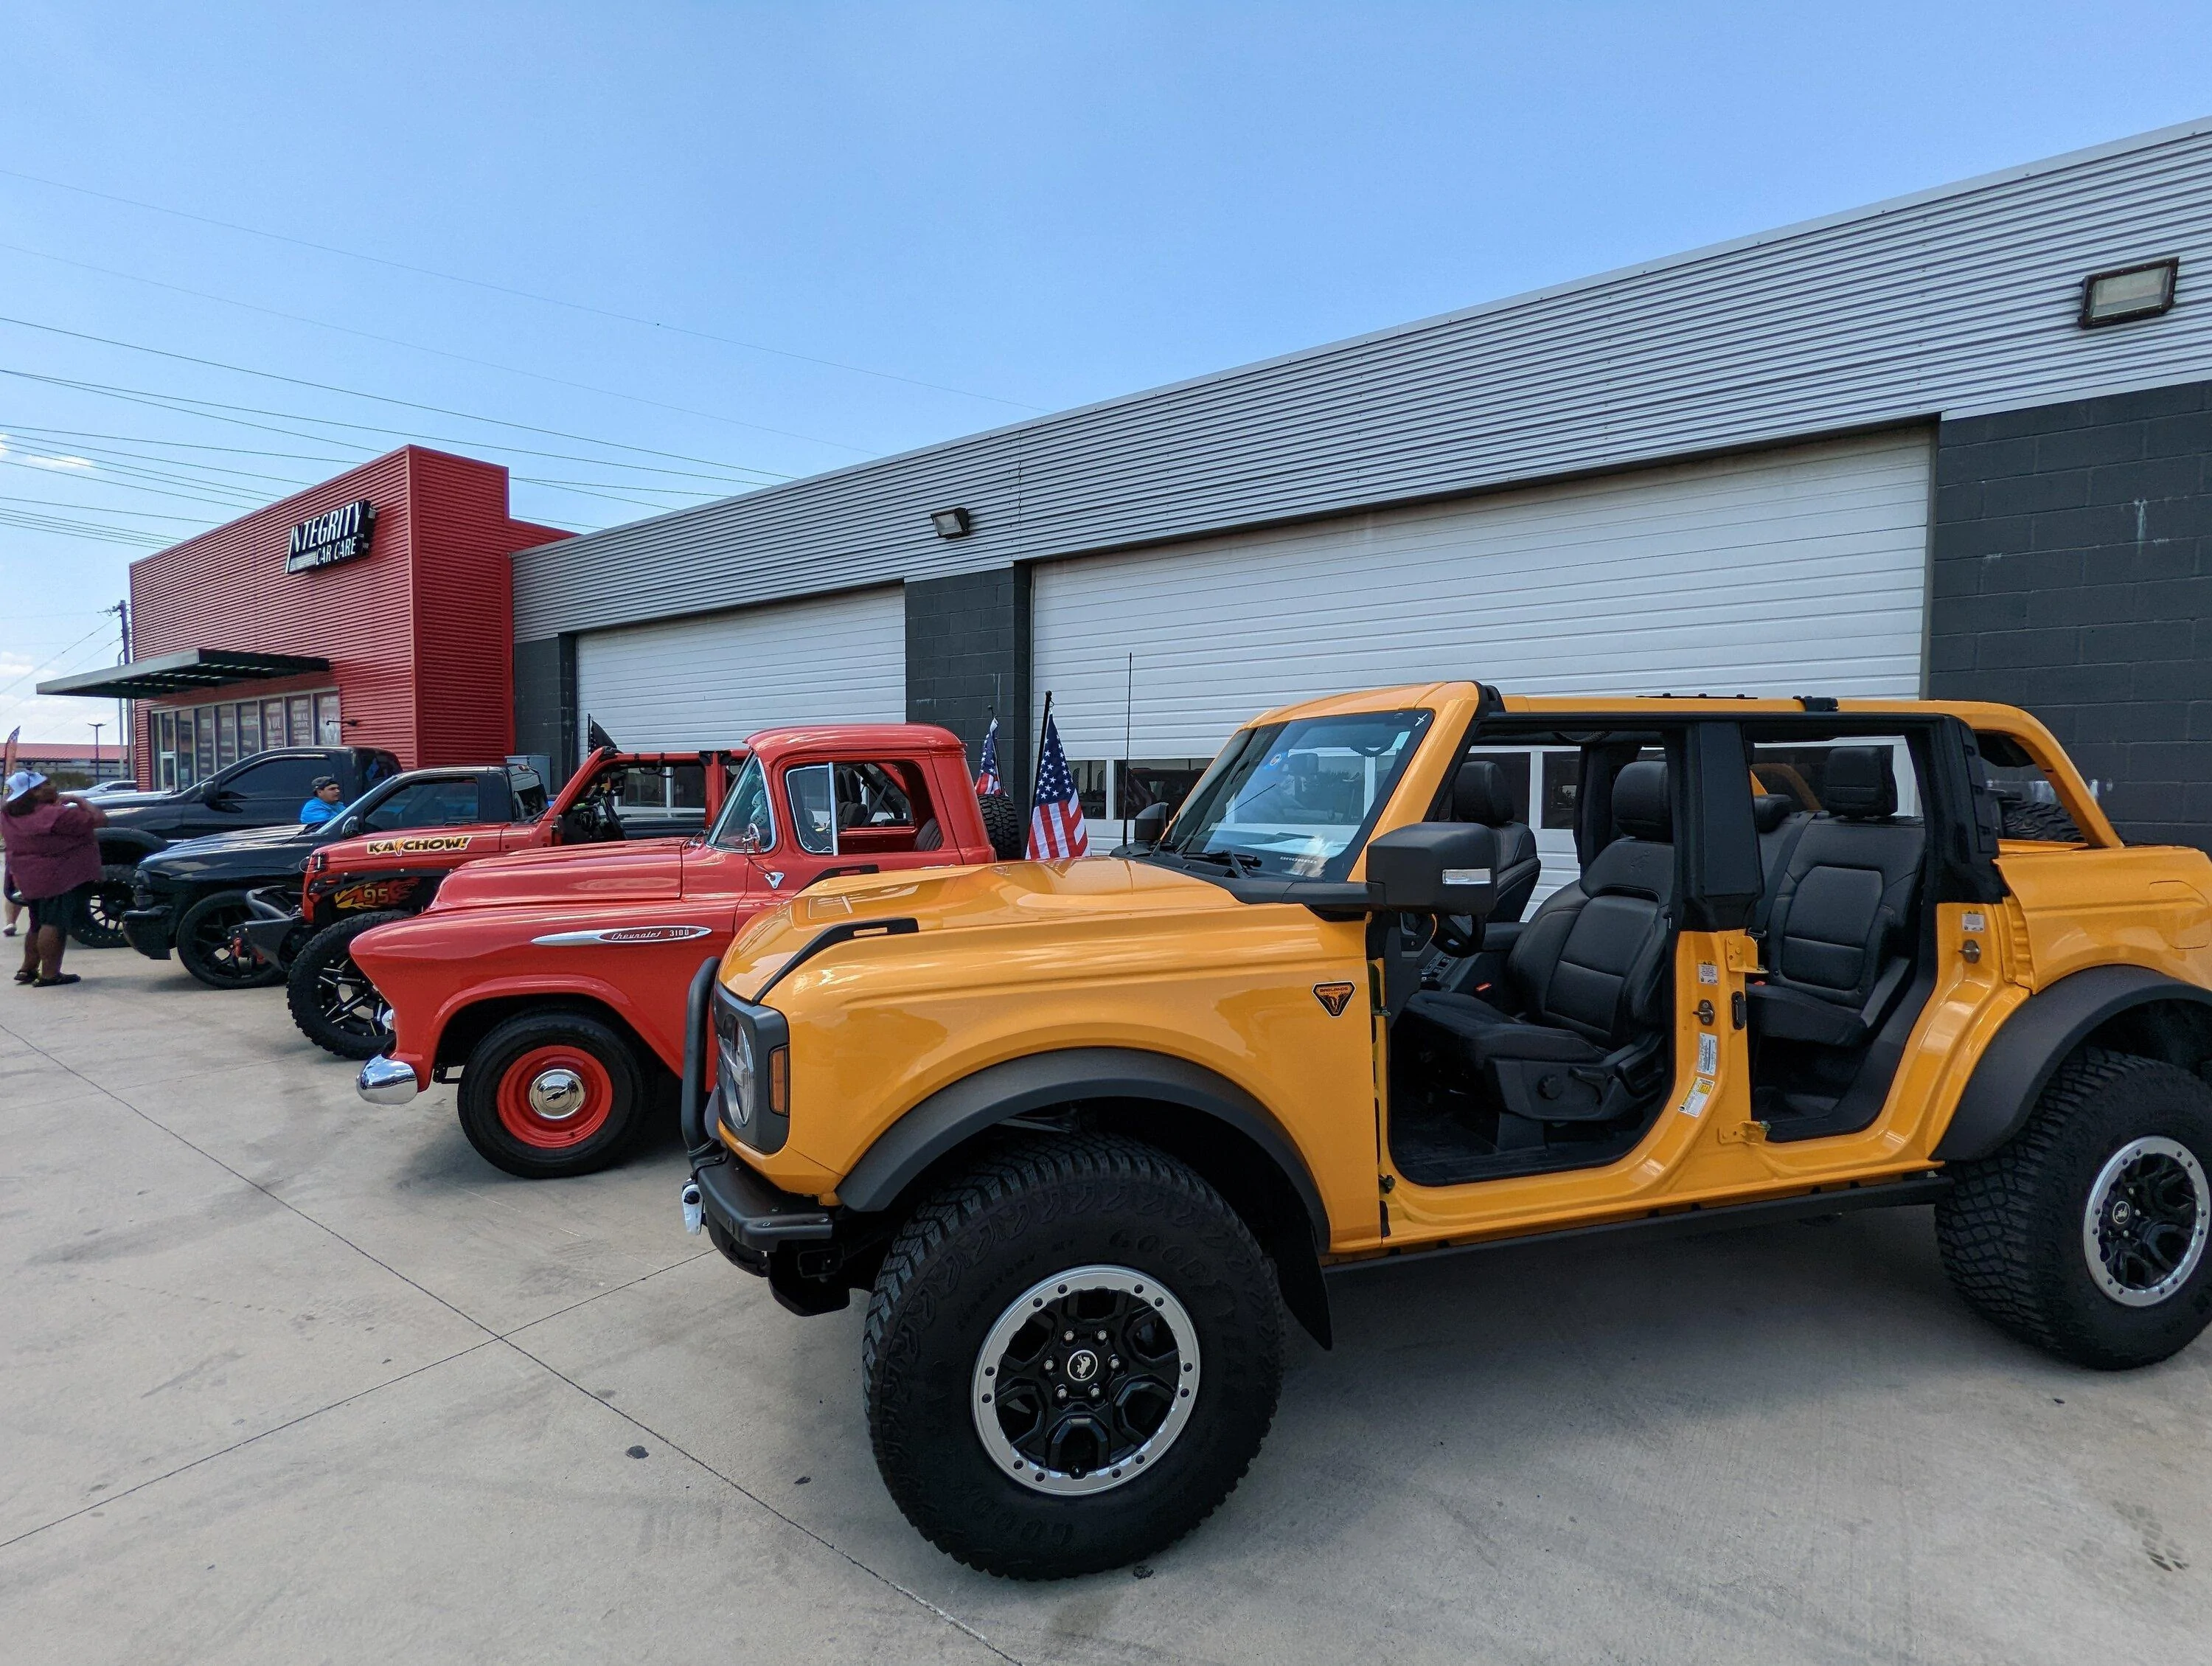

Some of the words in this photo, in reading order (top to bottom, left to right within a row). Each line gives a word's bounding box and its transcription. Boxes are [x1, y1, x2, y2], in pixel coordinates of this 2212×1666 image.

[285, 500, 365, 573] INTEGRITY
[316, 544, 332, 566] CAR
[334, 536, 358, 560] CARE
[364, 888, 389, 904] 95
[611, 930, 662, 940] Chevrolet
